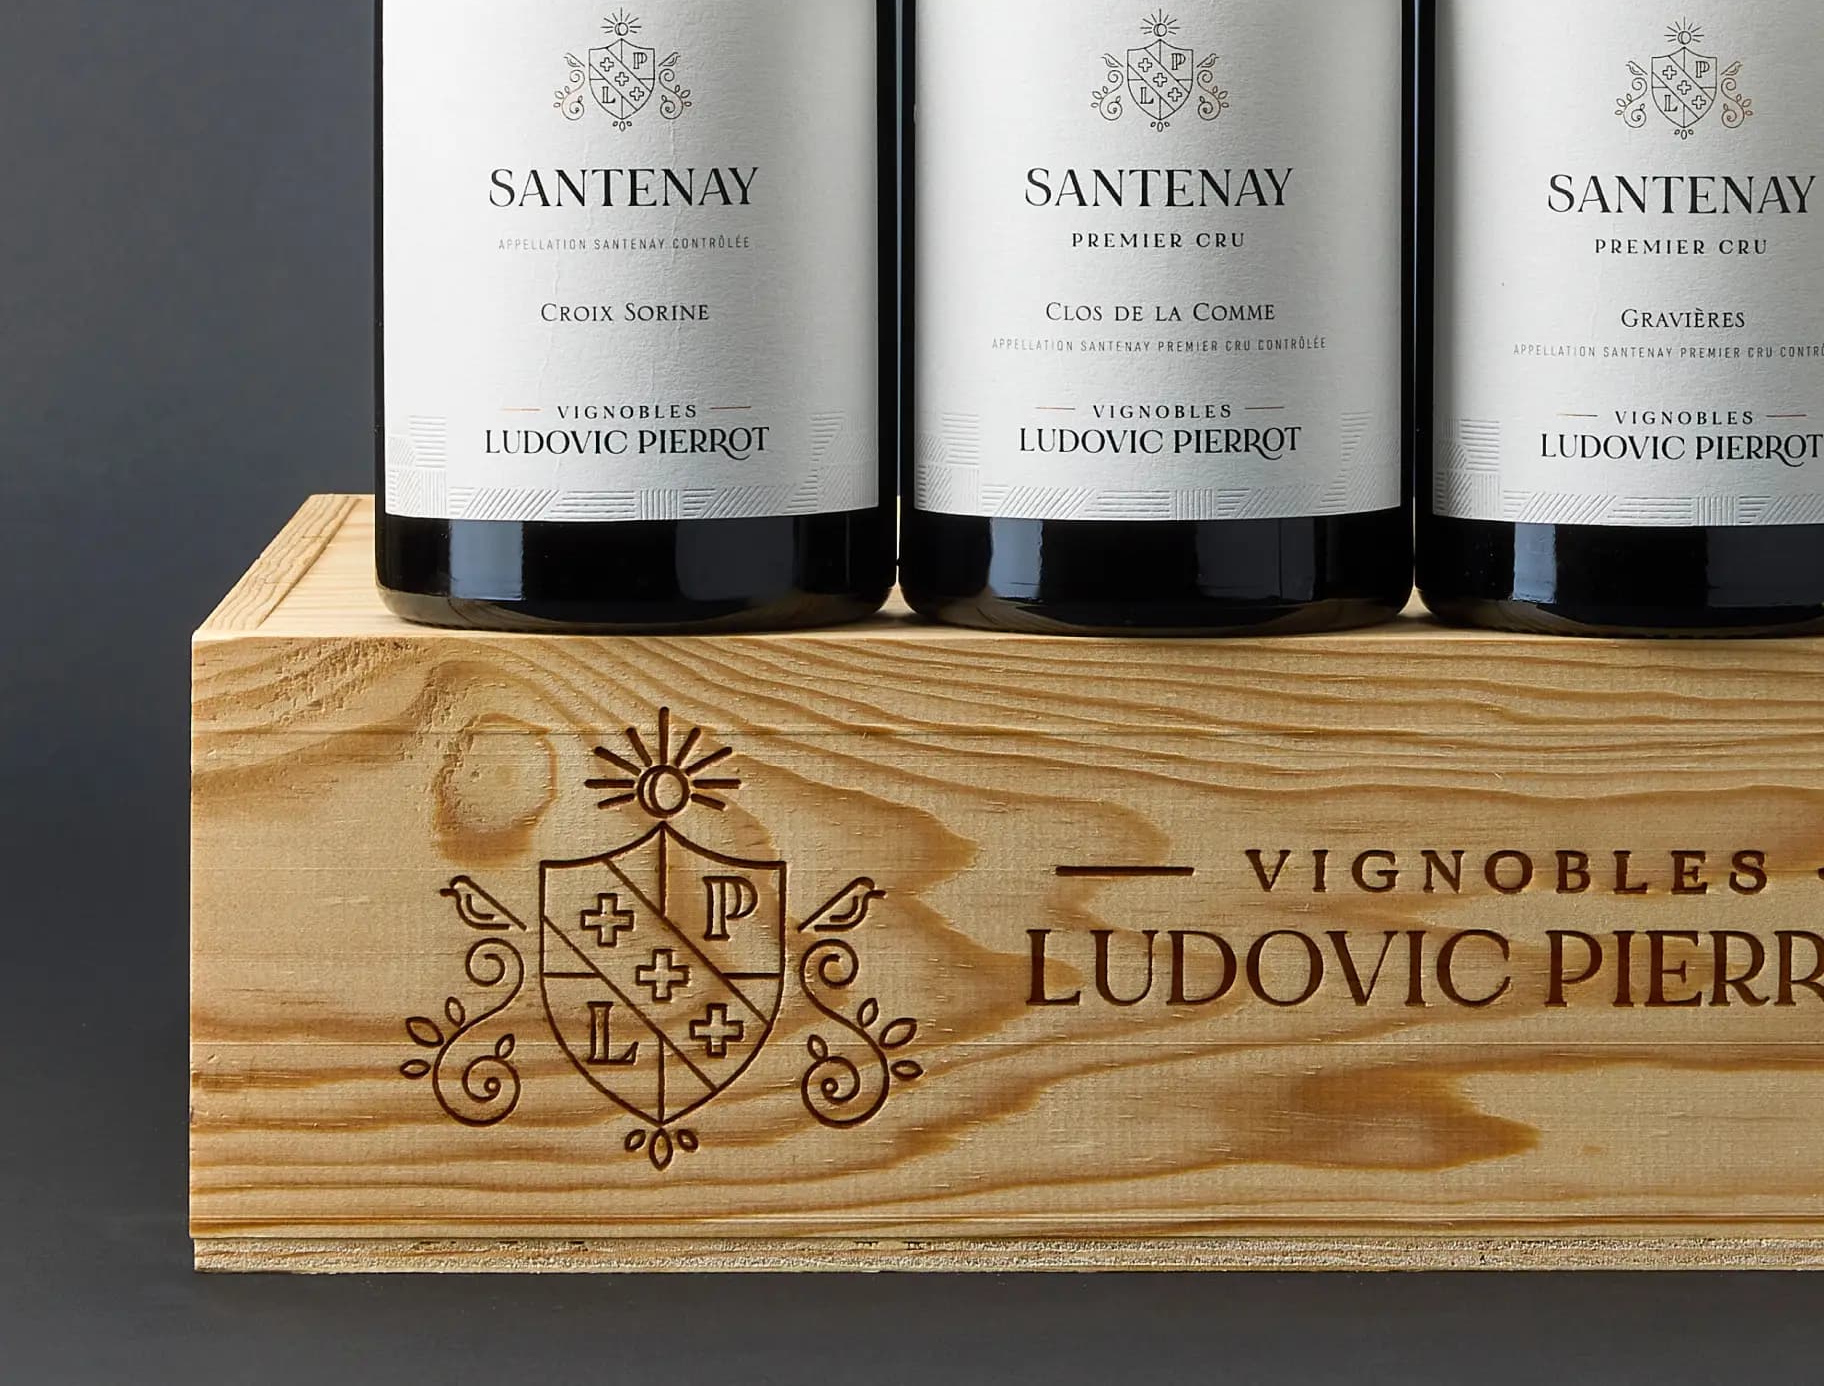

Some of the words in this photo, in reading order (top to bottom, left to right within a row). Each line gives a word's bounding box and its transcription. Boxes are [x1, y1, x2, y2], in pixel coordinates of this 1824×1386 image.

[489, 166, 759, 208] SANTENAY
[1025, 167, 1293, 208] SANTENAY
[1547, 173, 1815, 215] SANTENAY
[498, 237, 587, 251] APPELLATION
[593, 237, 666, 251] SANTENAY
[672, 234, 750, 250] CONTRÔLÉE
[1072, 232, 1183, 249] PREMIER
[1195, 232, 1244, 248] CRU
[1595, 238, 1705, 255] PREMIER
[1718, 239, 1767, 255] CRU
[991, 337, 1073, 353] APPELLATION
[1080, 339, 1151, 353] SANTENAY
[1157, 339, 1218, 353] PREMIER
[1225, 339, 1251, 352] CRU
[1257, 335, 1326, 351] CONTRÔLÉE
[1513, 343, 1596, 359] APPELLATION
[1603, 345, 1673, 359] SANTENAY
[1680, 346, 1741, 359] PREMIER
[1747, 345, 1773, 359] CRU
[557, 404, 697, 420] VIGNOBLES
[1092, 404, 1231, 419] VIGNOBLES
[1614, 410, 1753, 426] VIGNOBLES
[485, 429, 628, 455] LUDOVIC
[637, 426, 770, 461] PIERROT
[1019, 427, 1164, 455] LUDOVIC
[1173, 426, 1302, 461] PIERROT
[1541, 433, 1686, 461] LUDOVIC
[1695, 433, 1824, 468] PIERROT
[1244, 848, 1768, 896] VIGNOBLES
[1024, 928, 1511, 1009] LUDOVIC
[1543, 929, 1824, 1008] PIERR
